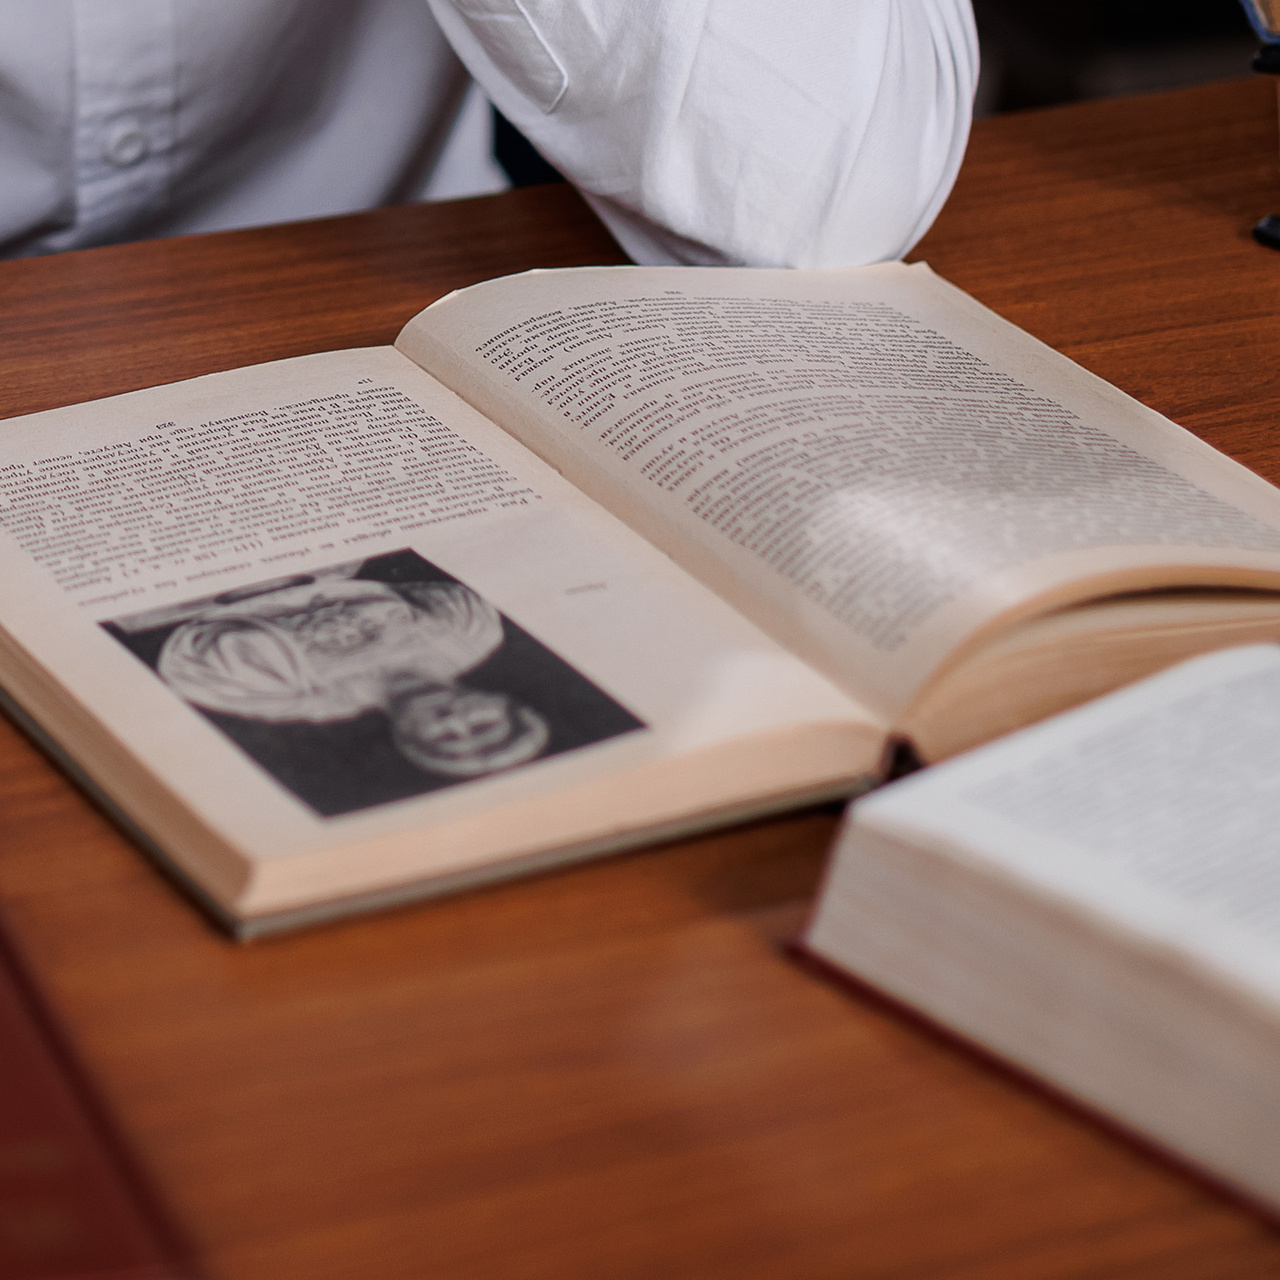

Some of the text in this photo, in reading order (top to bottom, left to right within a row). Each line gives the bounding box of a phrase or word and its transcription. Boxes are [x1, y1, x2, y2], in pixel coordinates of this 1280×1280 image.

[356, 386, 395, 395] «совет
[381, 396, 411, 405] риан
[292, 405, 327, 415] Риме
[327, 403, 377, 416] обратил
[405, 408, 426, 416] для
[200, 410, 269, 428] Возникнув
[242, 418, 268, 426] был
[261, 414, 322, 429] внимание
[335, 411, 373, 421] После
[366, 413, 399, 423] этого
[155, 421, 176, 430] 323
[257, 419, 329, 438] подавления
[367, 415, 436, 430] Император
[169, 427, 194, 436] еще
[175, 424, 239, 442] оформлен
[288, 420, 358, 439] длительные
[323, 428, 359, 438] лично
[138, 434, 163, 444] при
[177, 432, 234, 449] усиление
[418, 433, 459, 443] шения
[148, 440, 171, 449] как
[186, 436, 250, 456] восстаний
[224, 437, 317, 461] инспектировал
[230, 437, 281, 452] поездки
[335, 437, 392, 452] построил
[33, 455, 73, 466] «совет
[39, 447, 144, 472] государственное
[82, 450, 156, 471] укрепление
[170, 454, 209, 466] самые
[103, 457, 163, 475] волнений
